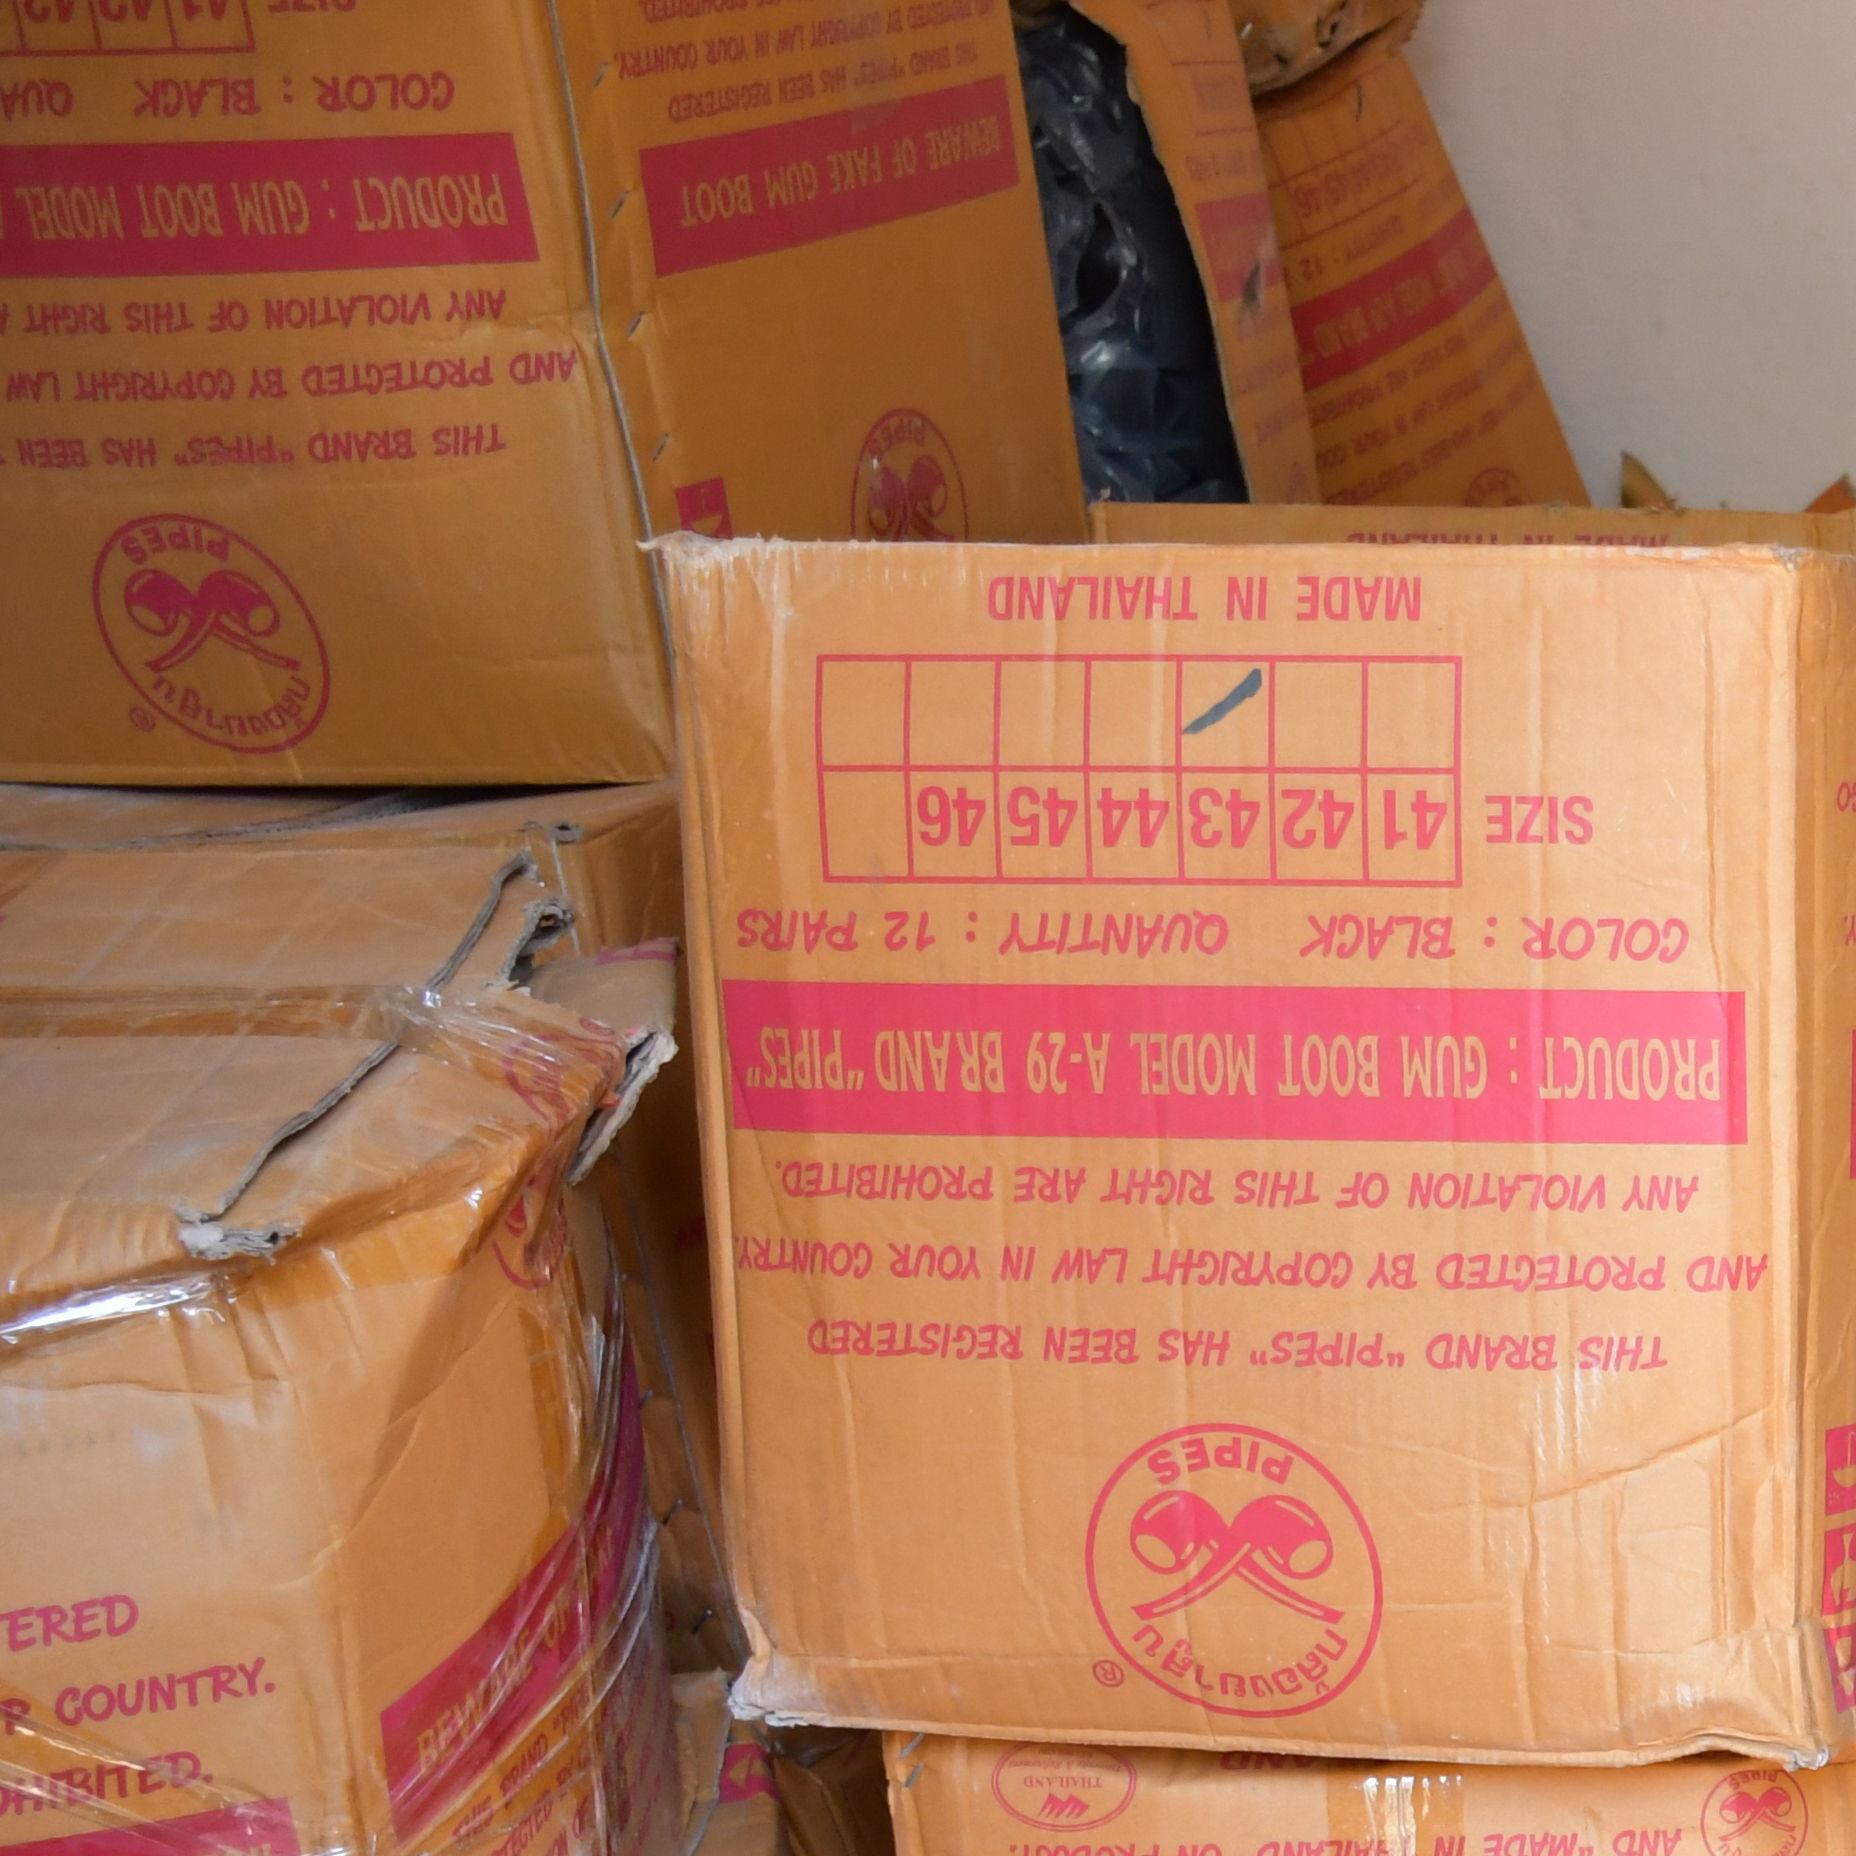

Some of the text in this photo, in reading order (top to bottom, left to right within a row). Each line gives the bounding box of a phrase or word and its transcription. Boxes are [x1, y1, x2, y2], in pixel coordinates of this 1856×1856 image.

[134, 70, 457, 118] COLOR BLACK
[15, 174, 509, 241] PRODUCT GUM BOOT MODEL
[682, 160, 819, 228] GUM BOOT
[25, 288, 507, 336] ANY VIOLATION OF THIS RIGHT
[119, 520, 233, 565] PIPES
[986, 574, 1422, 622] MADE IN THAILAND
[915, 784, 1594, 851] SIZE 41 42 43 44 45 46
[736, 907, 1691, 965] COLOR BLACK QUANTITY 12 PAIRS
[873, 1029, 1005, 1093] BRAND
[1026, 1030, 1110, 1095] A-29
[1129, 1032, 1256, 1096] MODEL
[1277, 1033, 1380, 1097] BOOT
[1401, 1034, 1488, 1099] GUM
[1539, 1036, 1721, 1101] PRODUCT
[806, 1318, 1024, 1361] REGISTERED
[1042, 1325, 1140, 1365] BEEN
[1157, 1327, 1231, 1367] HAS
[1424, 1331, 1559, 1372] BRAND
[1577, 1334, 1668, 1373] THIS
[1144, 1433, 1295, 1486] PIPES
[54, 1656, 276, 1726] COUNTRY.
[1023, 1775, 1102, 1789] THAILAND
